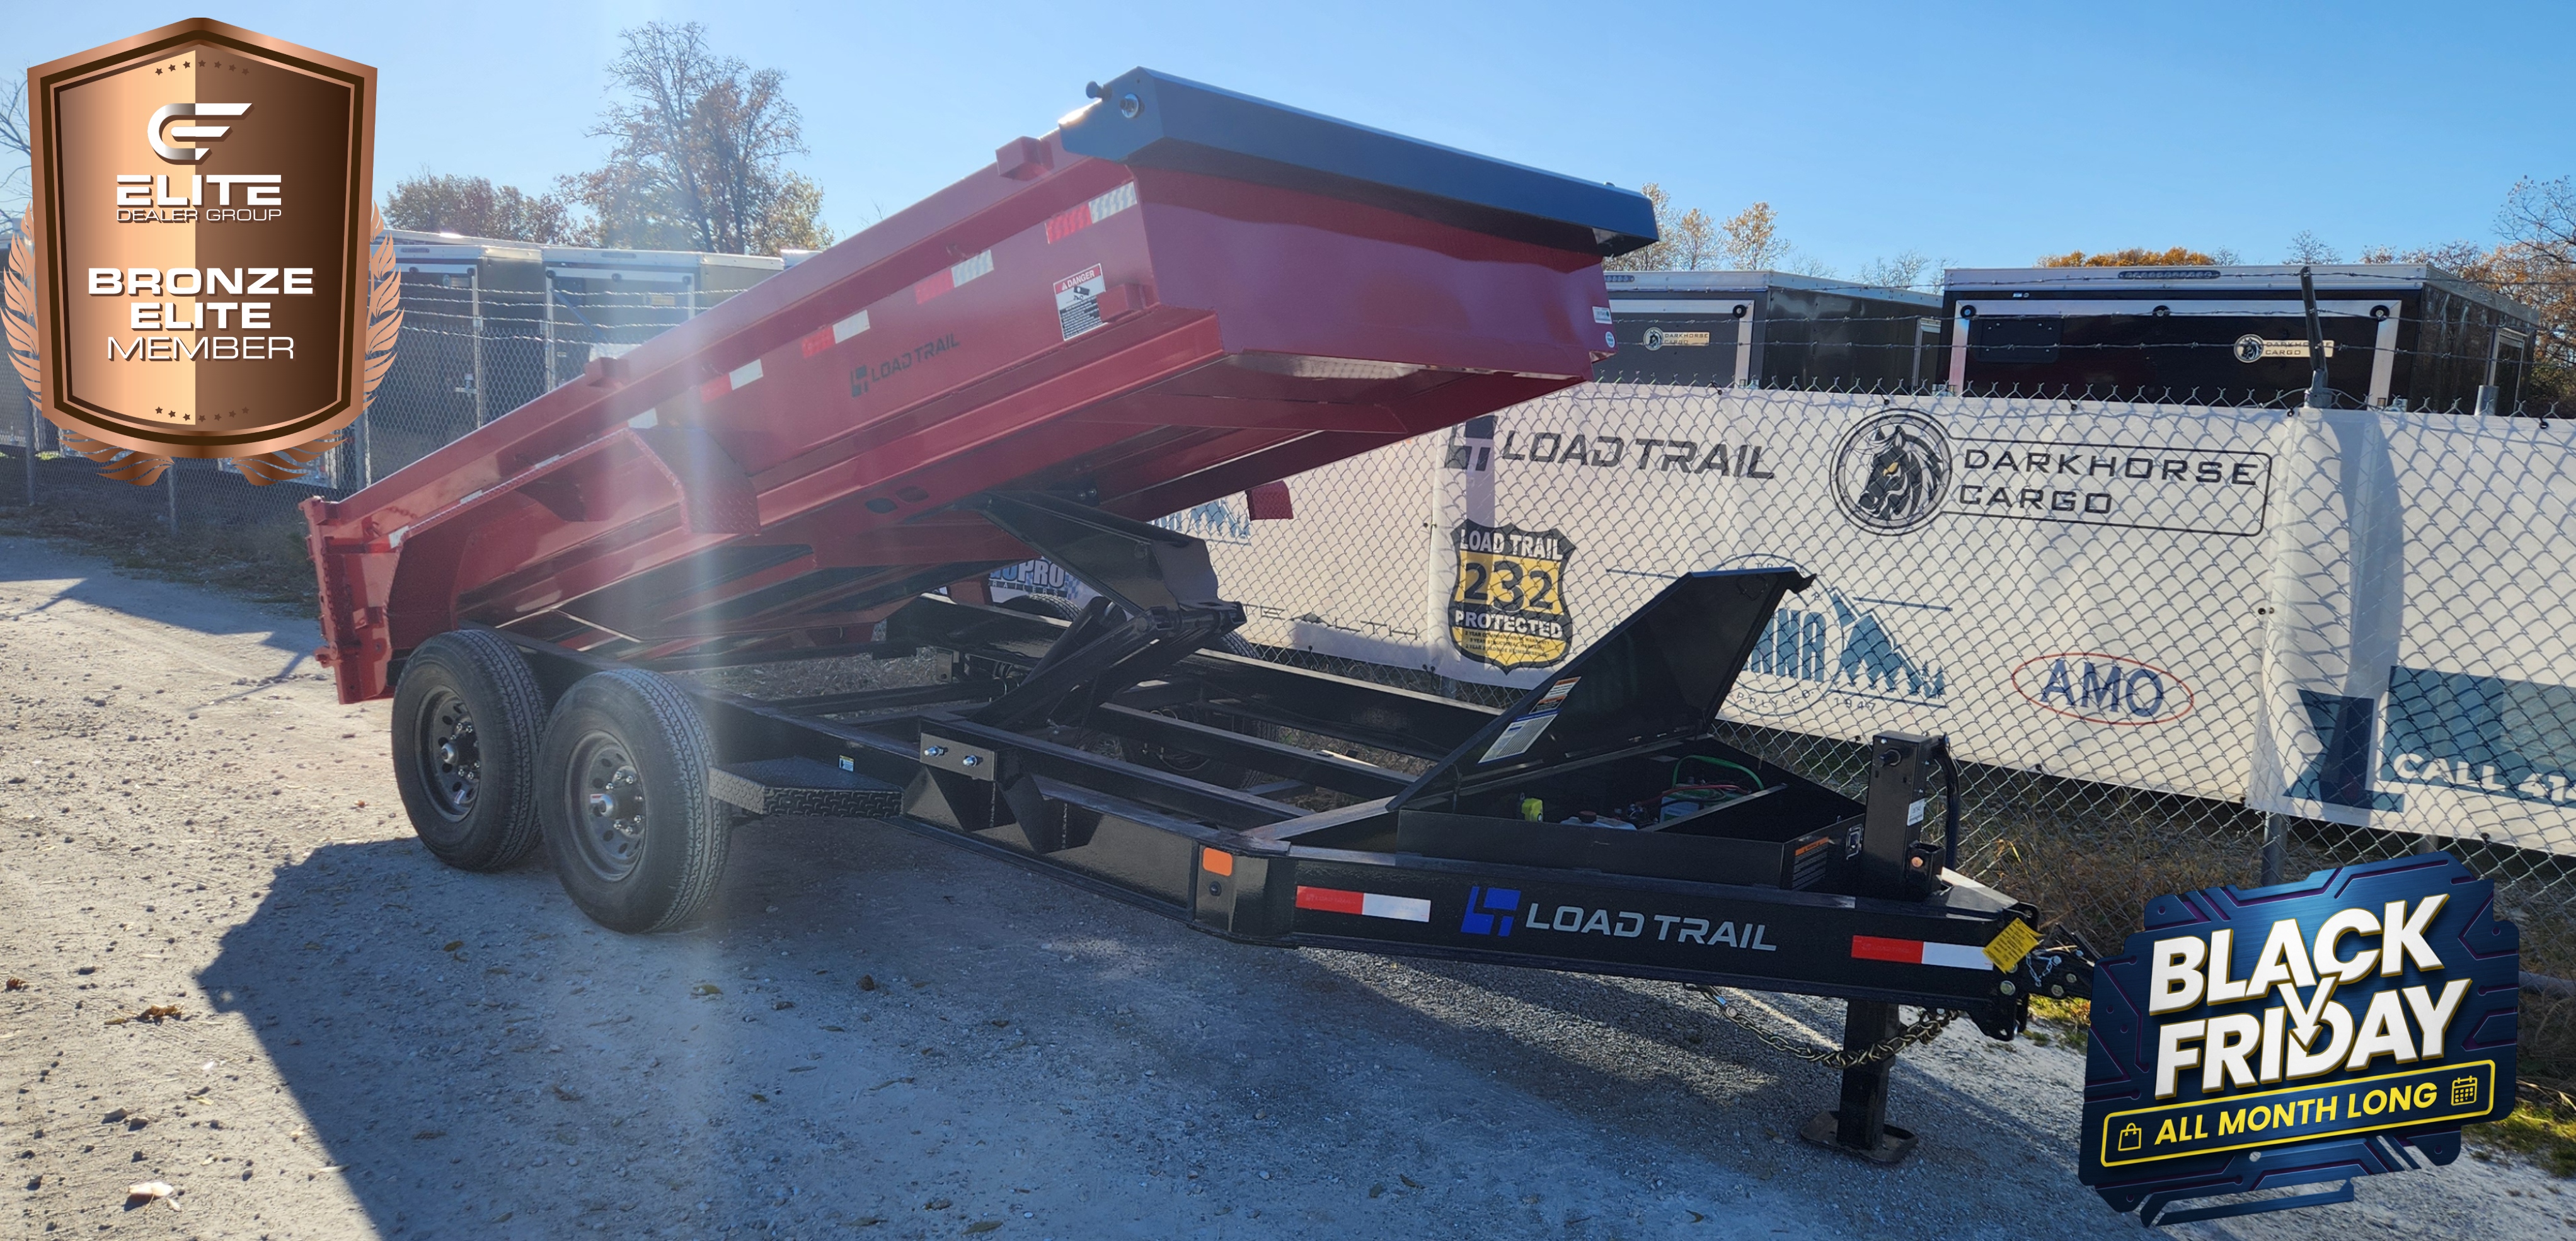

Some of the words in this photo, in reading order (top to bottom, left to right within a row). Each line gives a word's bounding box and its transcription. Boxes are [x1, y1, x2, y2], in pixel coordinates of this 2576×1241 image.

[1067, 270, 1095, 288] DANGER
[871, 352, 912, 382] LOAD
[914, 333, 960, 363] TRAIL
[1502, 430, 1625, 467] LOAD
[1636, 438, 1775, 480] TRAIL
[1964, 448, 2258, 486] DARKHORSE
[1959, 484, 2112, 515] CARGO
[1459, 529, 1505, 554] LOAD
[1510, 534, 1564, 561] TRAIL
[992, 581, 1059, 596] RAILERS
[1463, 560, 1553, 612] 232
[1455, 609, 1563, 639] PROTECTED
[1834, 697, 1877, 711] 1947
[2039, 658, 2164, 717] AMO
[2393, 753, 2505, 792] CALL
[1526, 903, 1645, 938] LOAD
[1654, 915, 1777, 951] TRAIL
